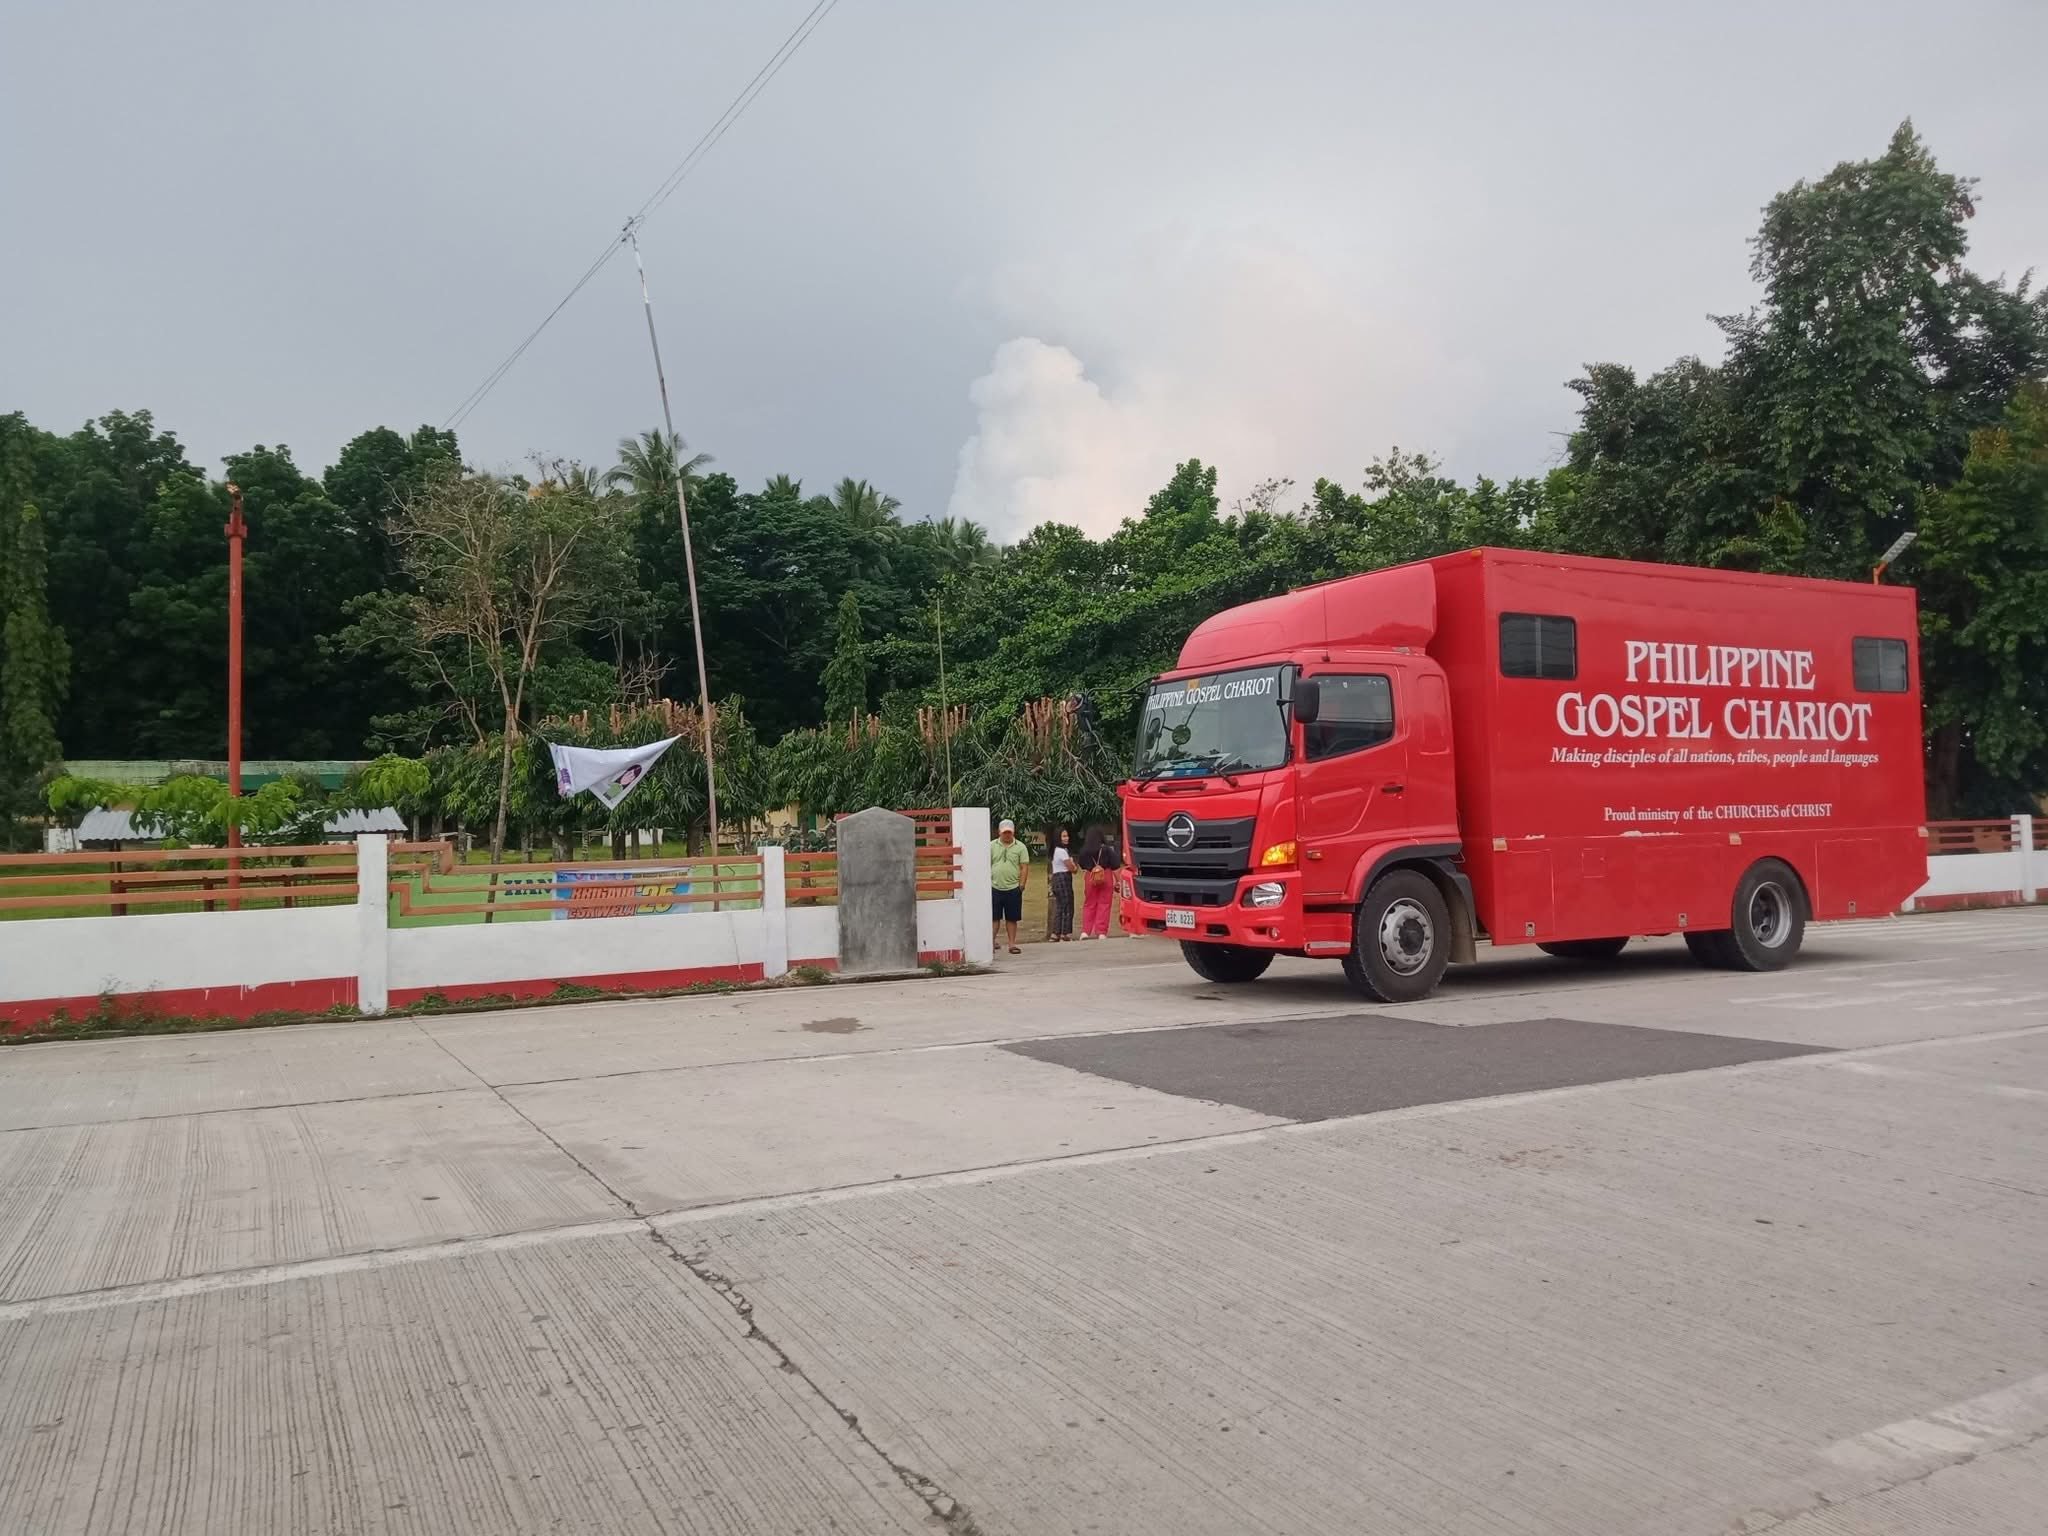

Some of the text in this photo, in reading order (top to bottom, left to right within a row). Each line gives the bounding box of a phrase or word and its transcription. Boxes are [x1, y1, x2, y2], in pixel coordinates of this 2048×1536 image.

[1624, 640, 1816, 690] PHILIPPINE
[1147, 677, 1274, 710] PHILIPPINE GOSPEL CHARIOT
[1556, 691, 1873, 741] GOSPEL CHARIOT
[1550, 747, 1879, 768] Making disciples of all nations, tribes, people and languages
[1604, 803, 1833, 825] Proud ministry of the CHURCHES of CHRIST
